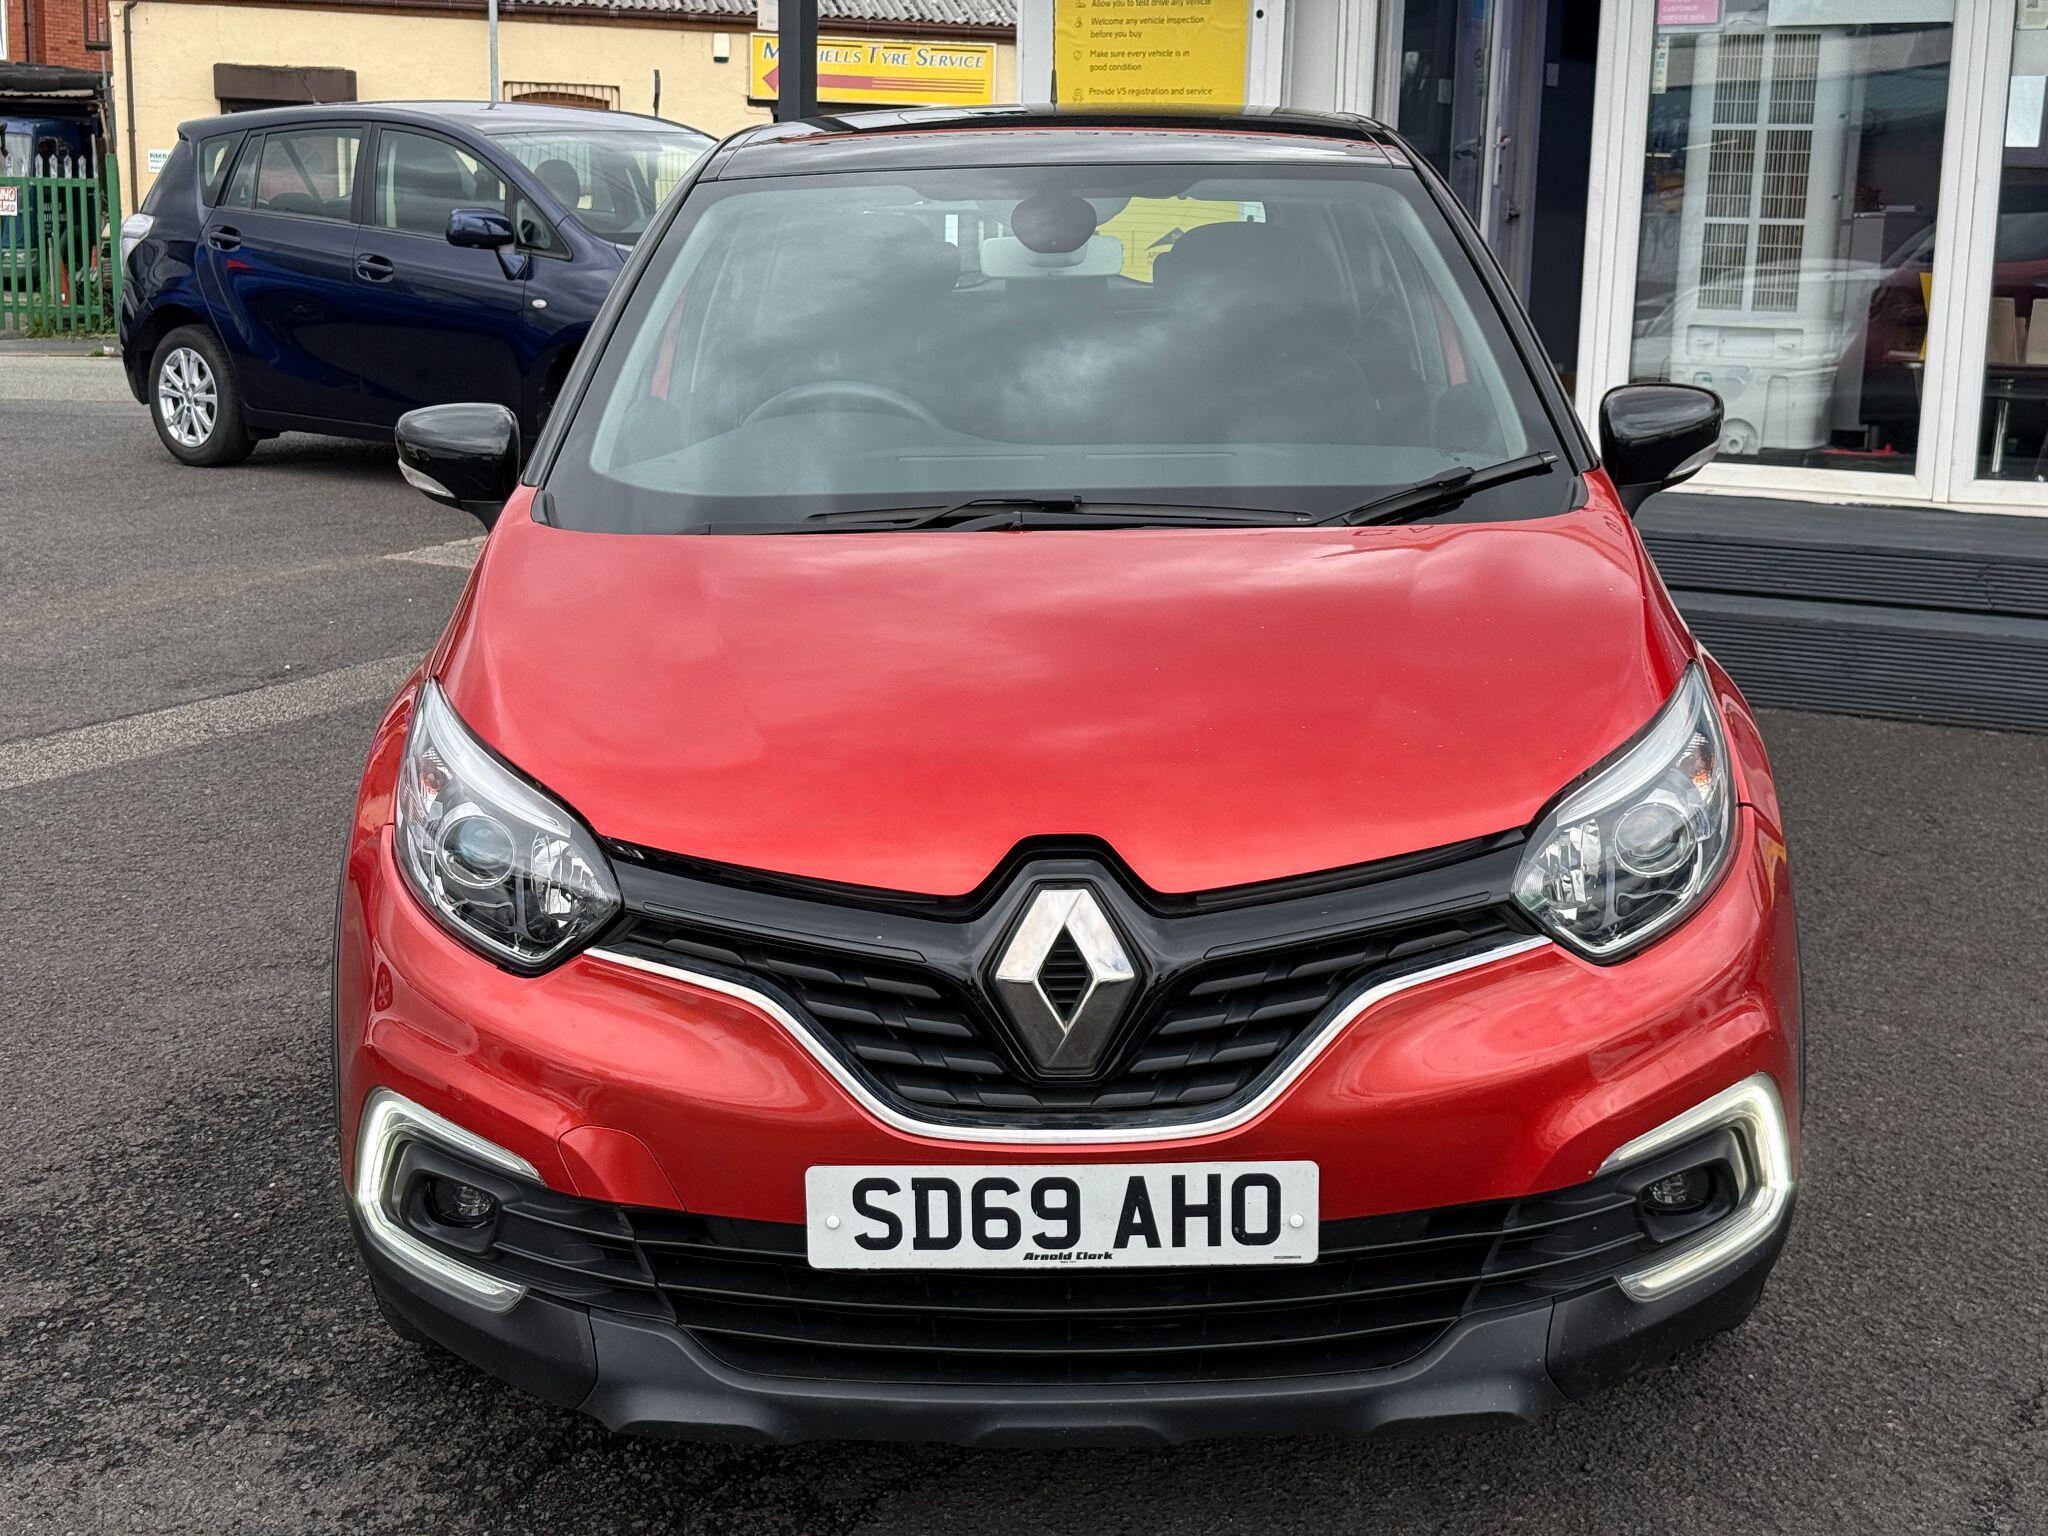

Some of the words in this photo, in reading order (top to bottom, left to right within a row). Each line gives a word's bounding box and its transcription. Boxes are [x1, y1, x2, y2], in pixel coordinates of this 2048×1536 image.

[1113, 0, 1125, 8] you
[1139, 17, 1165, 25] vehicle
[1167, 16, 1205, 25] inspection
[1128, 31, 1143, 39] buy
[763, 42, 863, 64] MELLS
[868, 46, 910, 65] TYRE
[915, 48, 984, 68] SERVICE
[1148, 49, 1174, 57] vehicle
[1175, 49, 1181, 57] is
[1089, 63, 1107, 72] good
[1108, 63, 1142, 71] condition
[1128, 87, 1169, 96] registration
[1170, 87, 1184, 95] and
[1186, 87, 1213, 95] service
[852, 1176, 1082, 1251] SD69
[1112, 1173, 1282, 1249] AHO
[1023, 1252, 1073, 1261] Arnold
[1075, 1251, 1114, 1260] Clark
